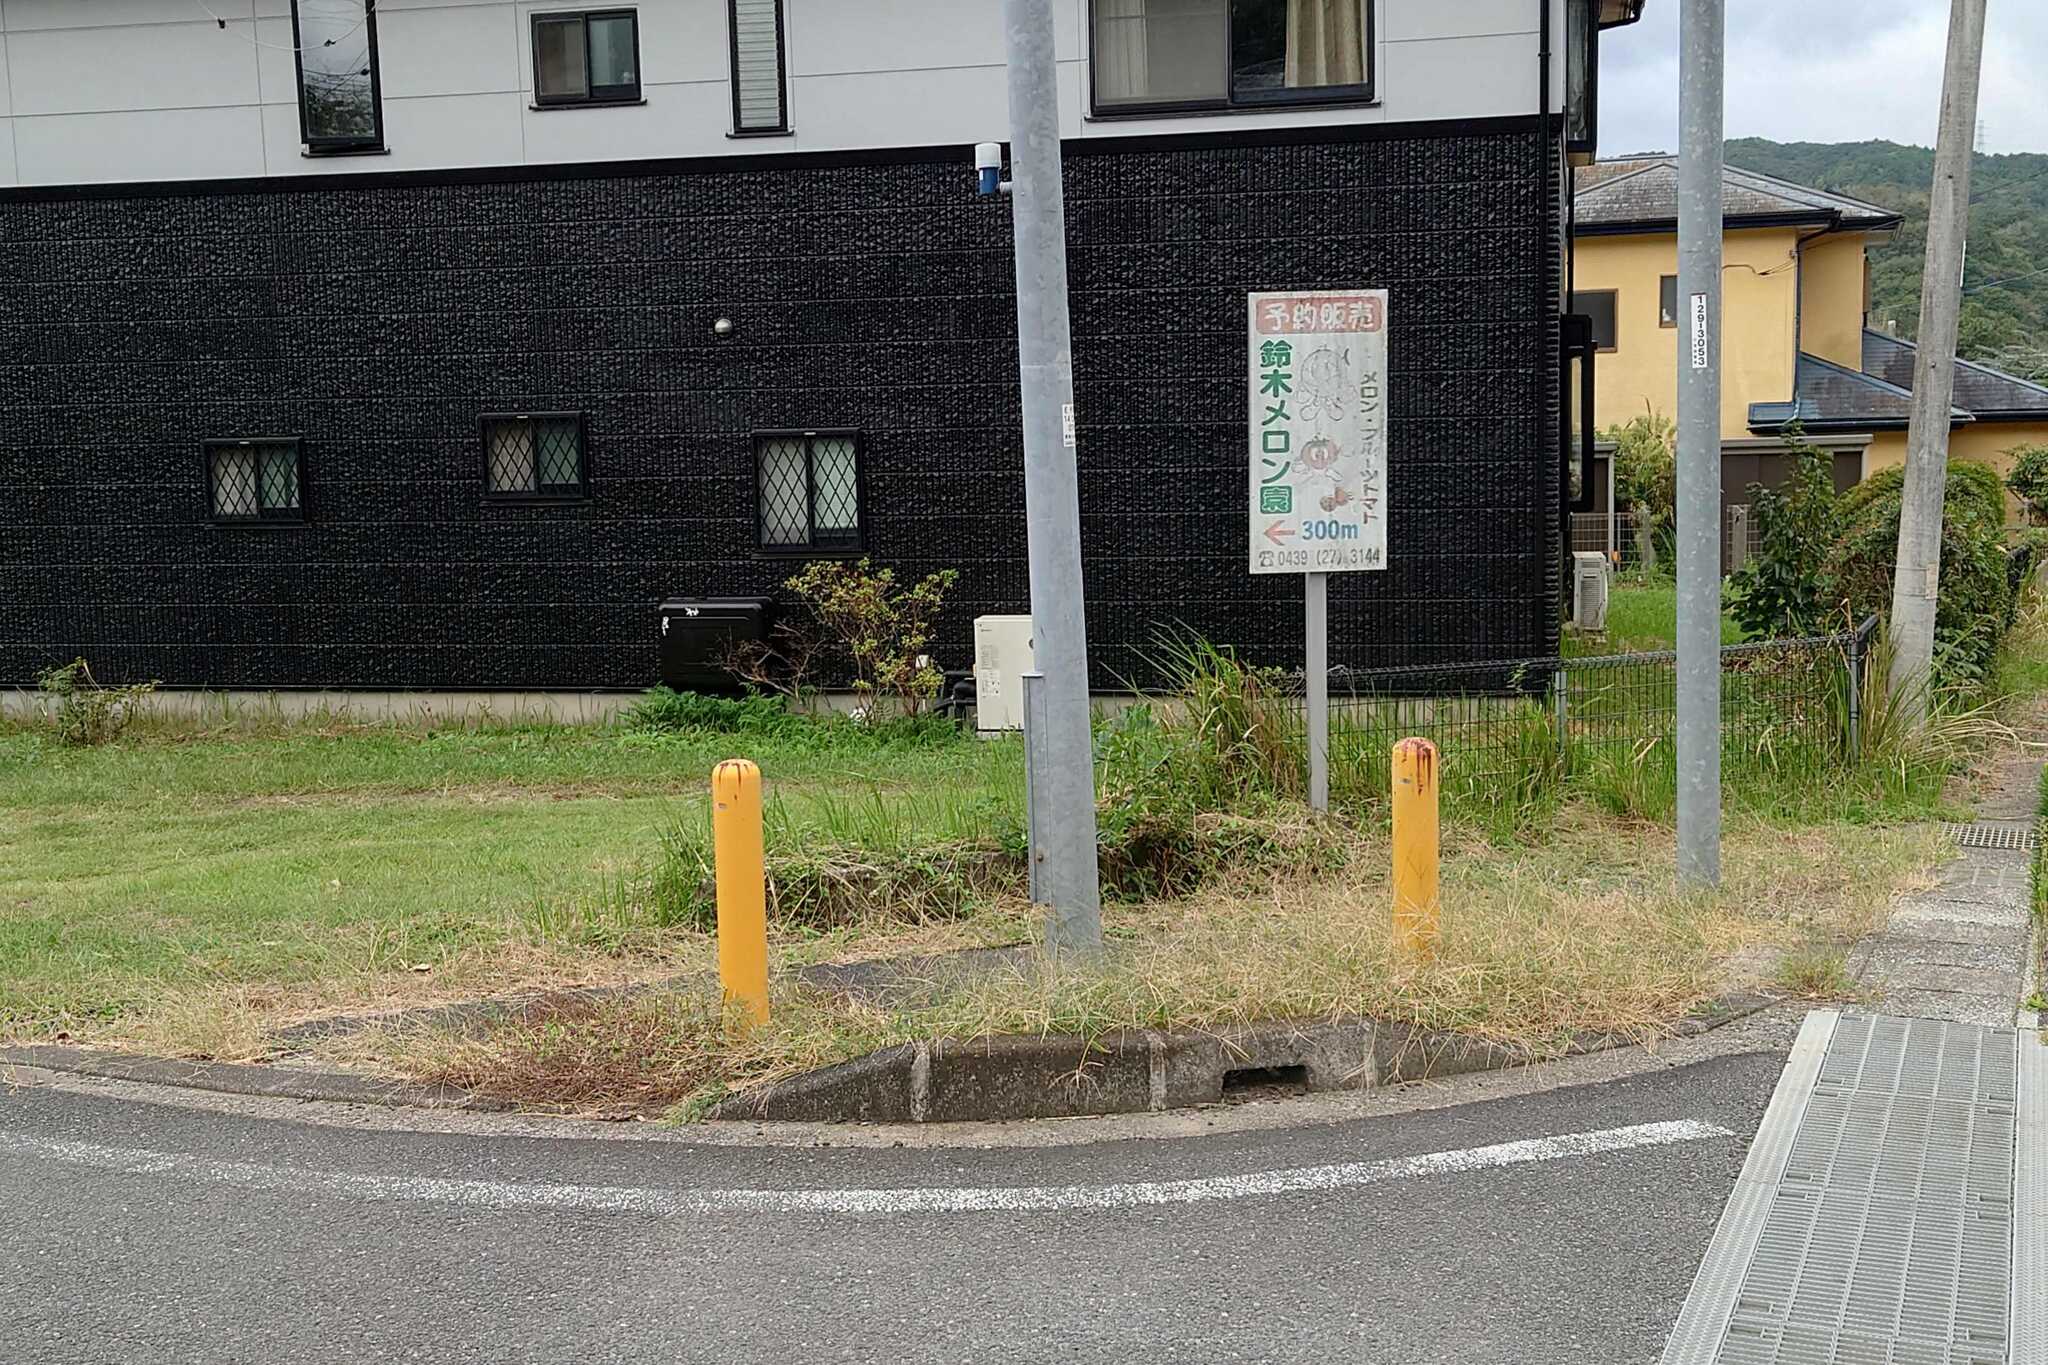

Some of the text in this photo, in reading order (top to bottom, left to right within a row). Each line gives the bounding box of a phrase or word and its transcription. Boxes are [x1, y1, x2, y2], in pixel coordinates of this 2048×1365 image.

[1260, 340, 1292, 514] 鈴木メロン園
[1302, 520, 1358, 540] 300m
[1278, 547, 1380, 566] 0439 (27) 3144
